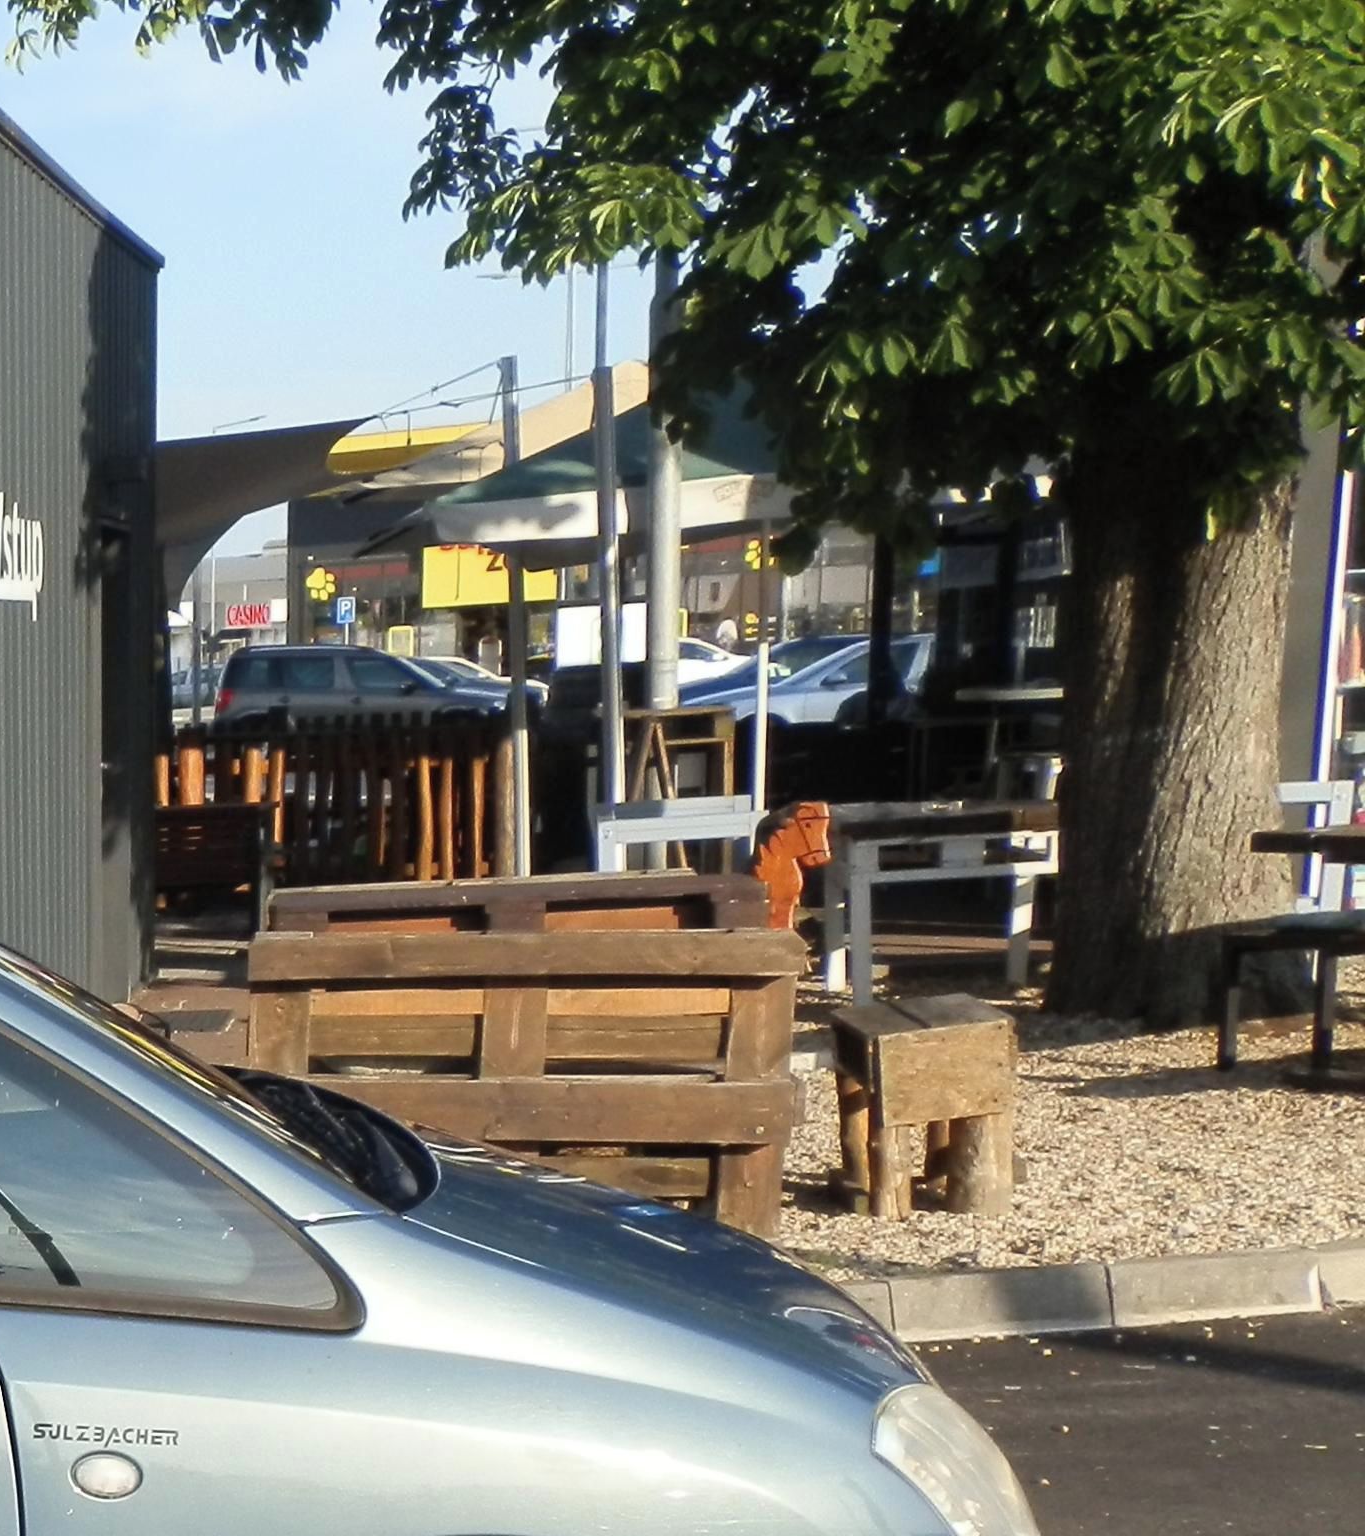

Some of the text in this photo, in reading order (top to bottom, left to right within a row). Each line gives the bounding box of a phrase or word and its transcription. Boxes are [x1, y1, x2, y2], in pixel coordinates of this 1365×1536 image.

[227, 602, 270, 626] CASINO
[341, 601, 351, 615] P
[33, 1423, 179, 1447] SULZBACHER
